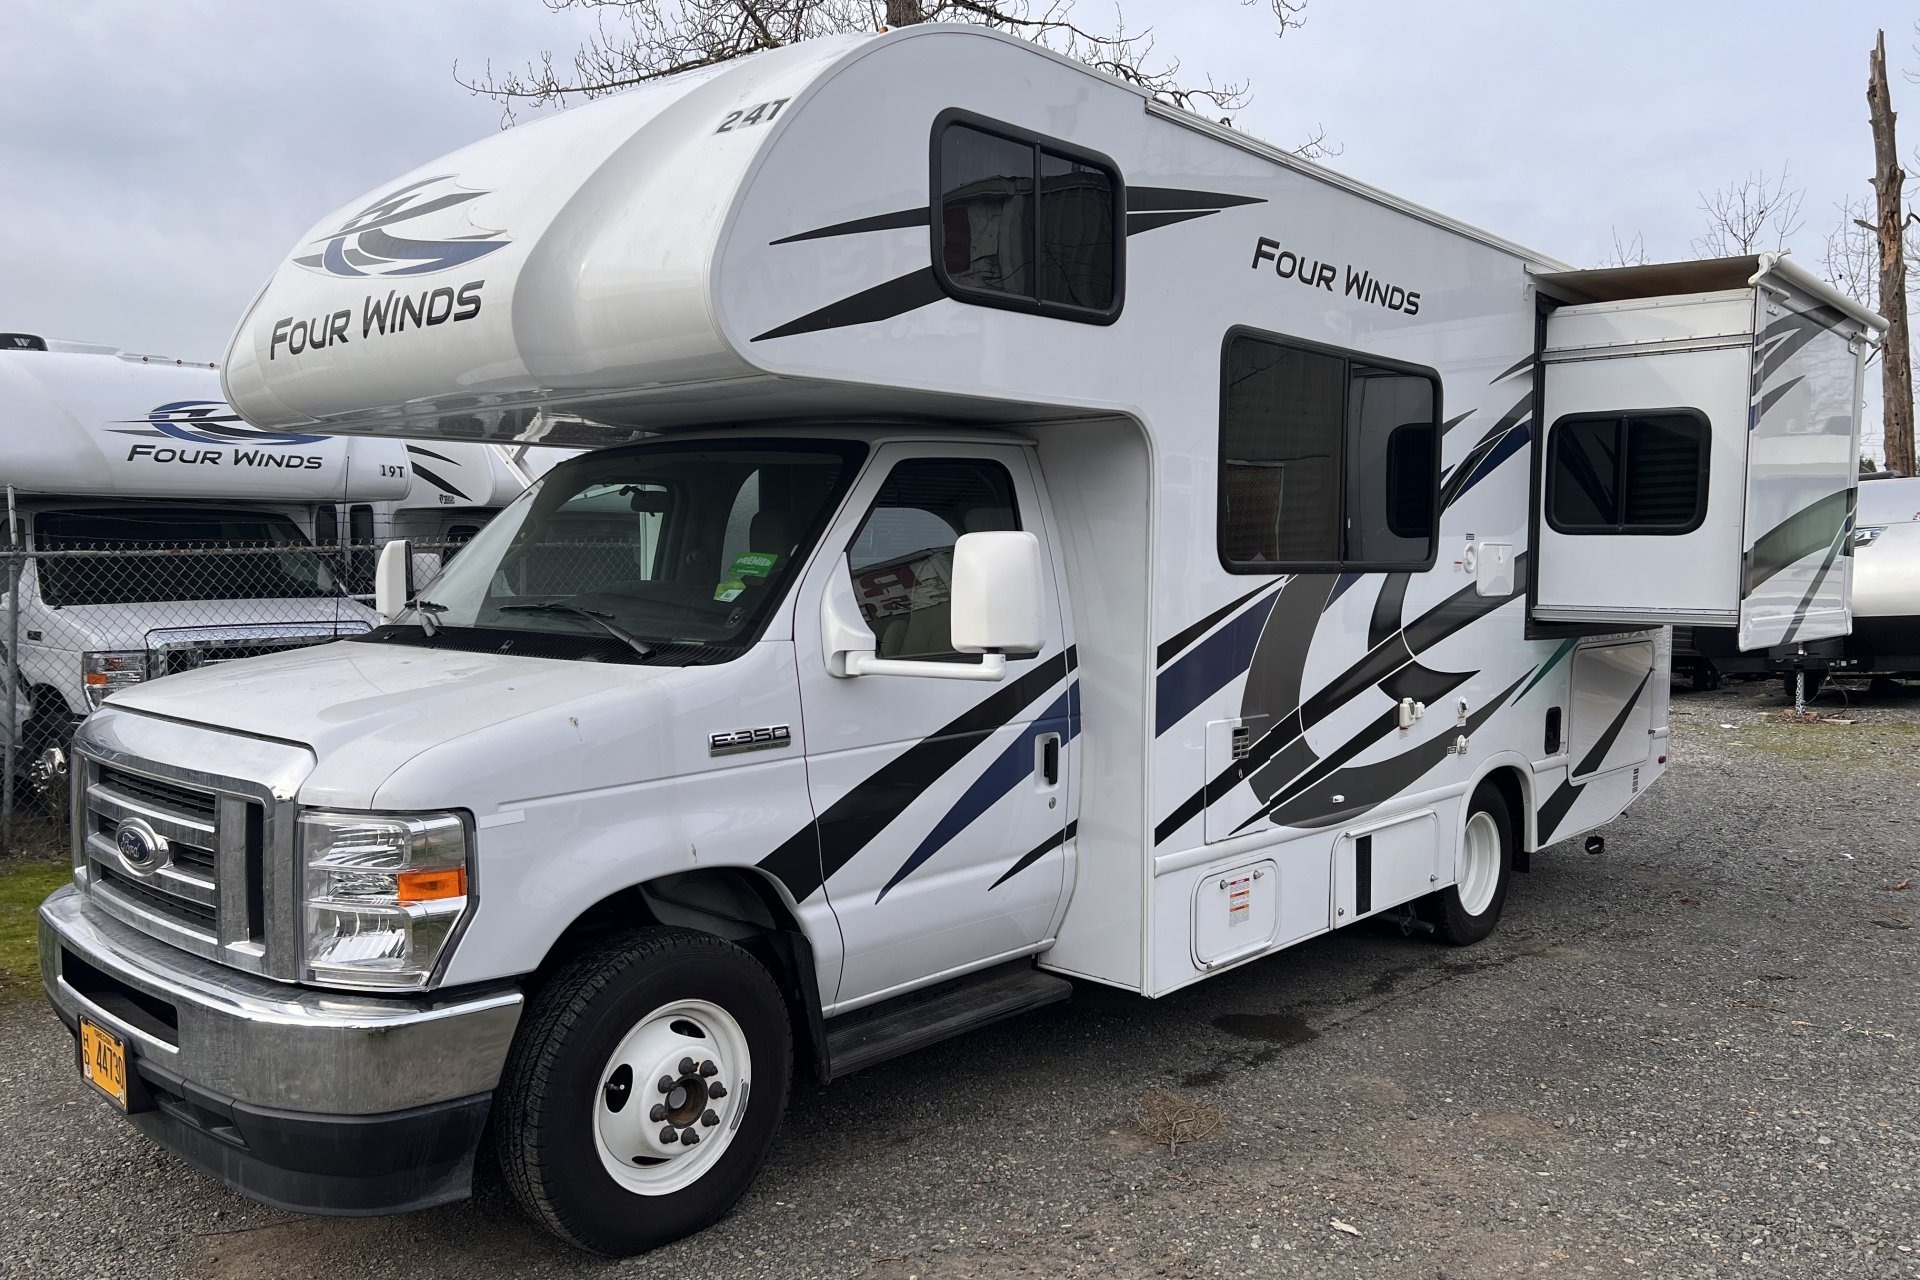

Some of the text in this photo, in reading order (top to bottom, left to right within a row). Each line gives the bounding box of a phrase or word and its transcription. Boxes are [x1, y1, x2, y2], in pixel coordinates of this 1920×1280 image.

[716, 96, 792, 133] 24T
[1252, 236, 1421, 316] FOUR WINDS
[270, 280, 485, 361] FOUR WINDS
[127, 444, 323, 470] FOUR WINDS
[381, 464, 405, 478] 19T
[736, 555, 772, 567] PREMIER
[711, 725, 790, 748] E-350
[120, 832, 140, 858] Ford
